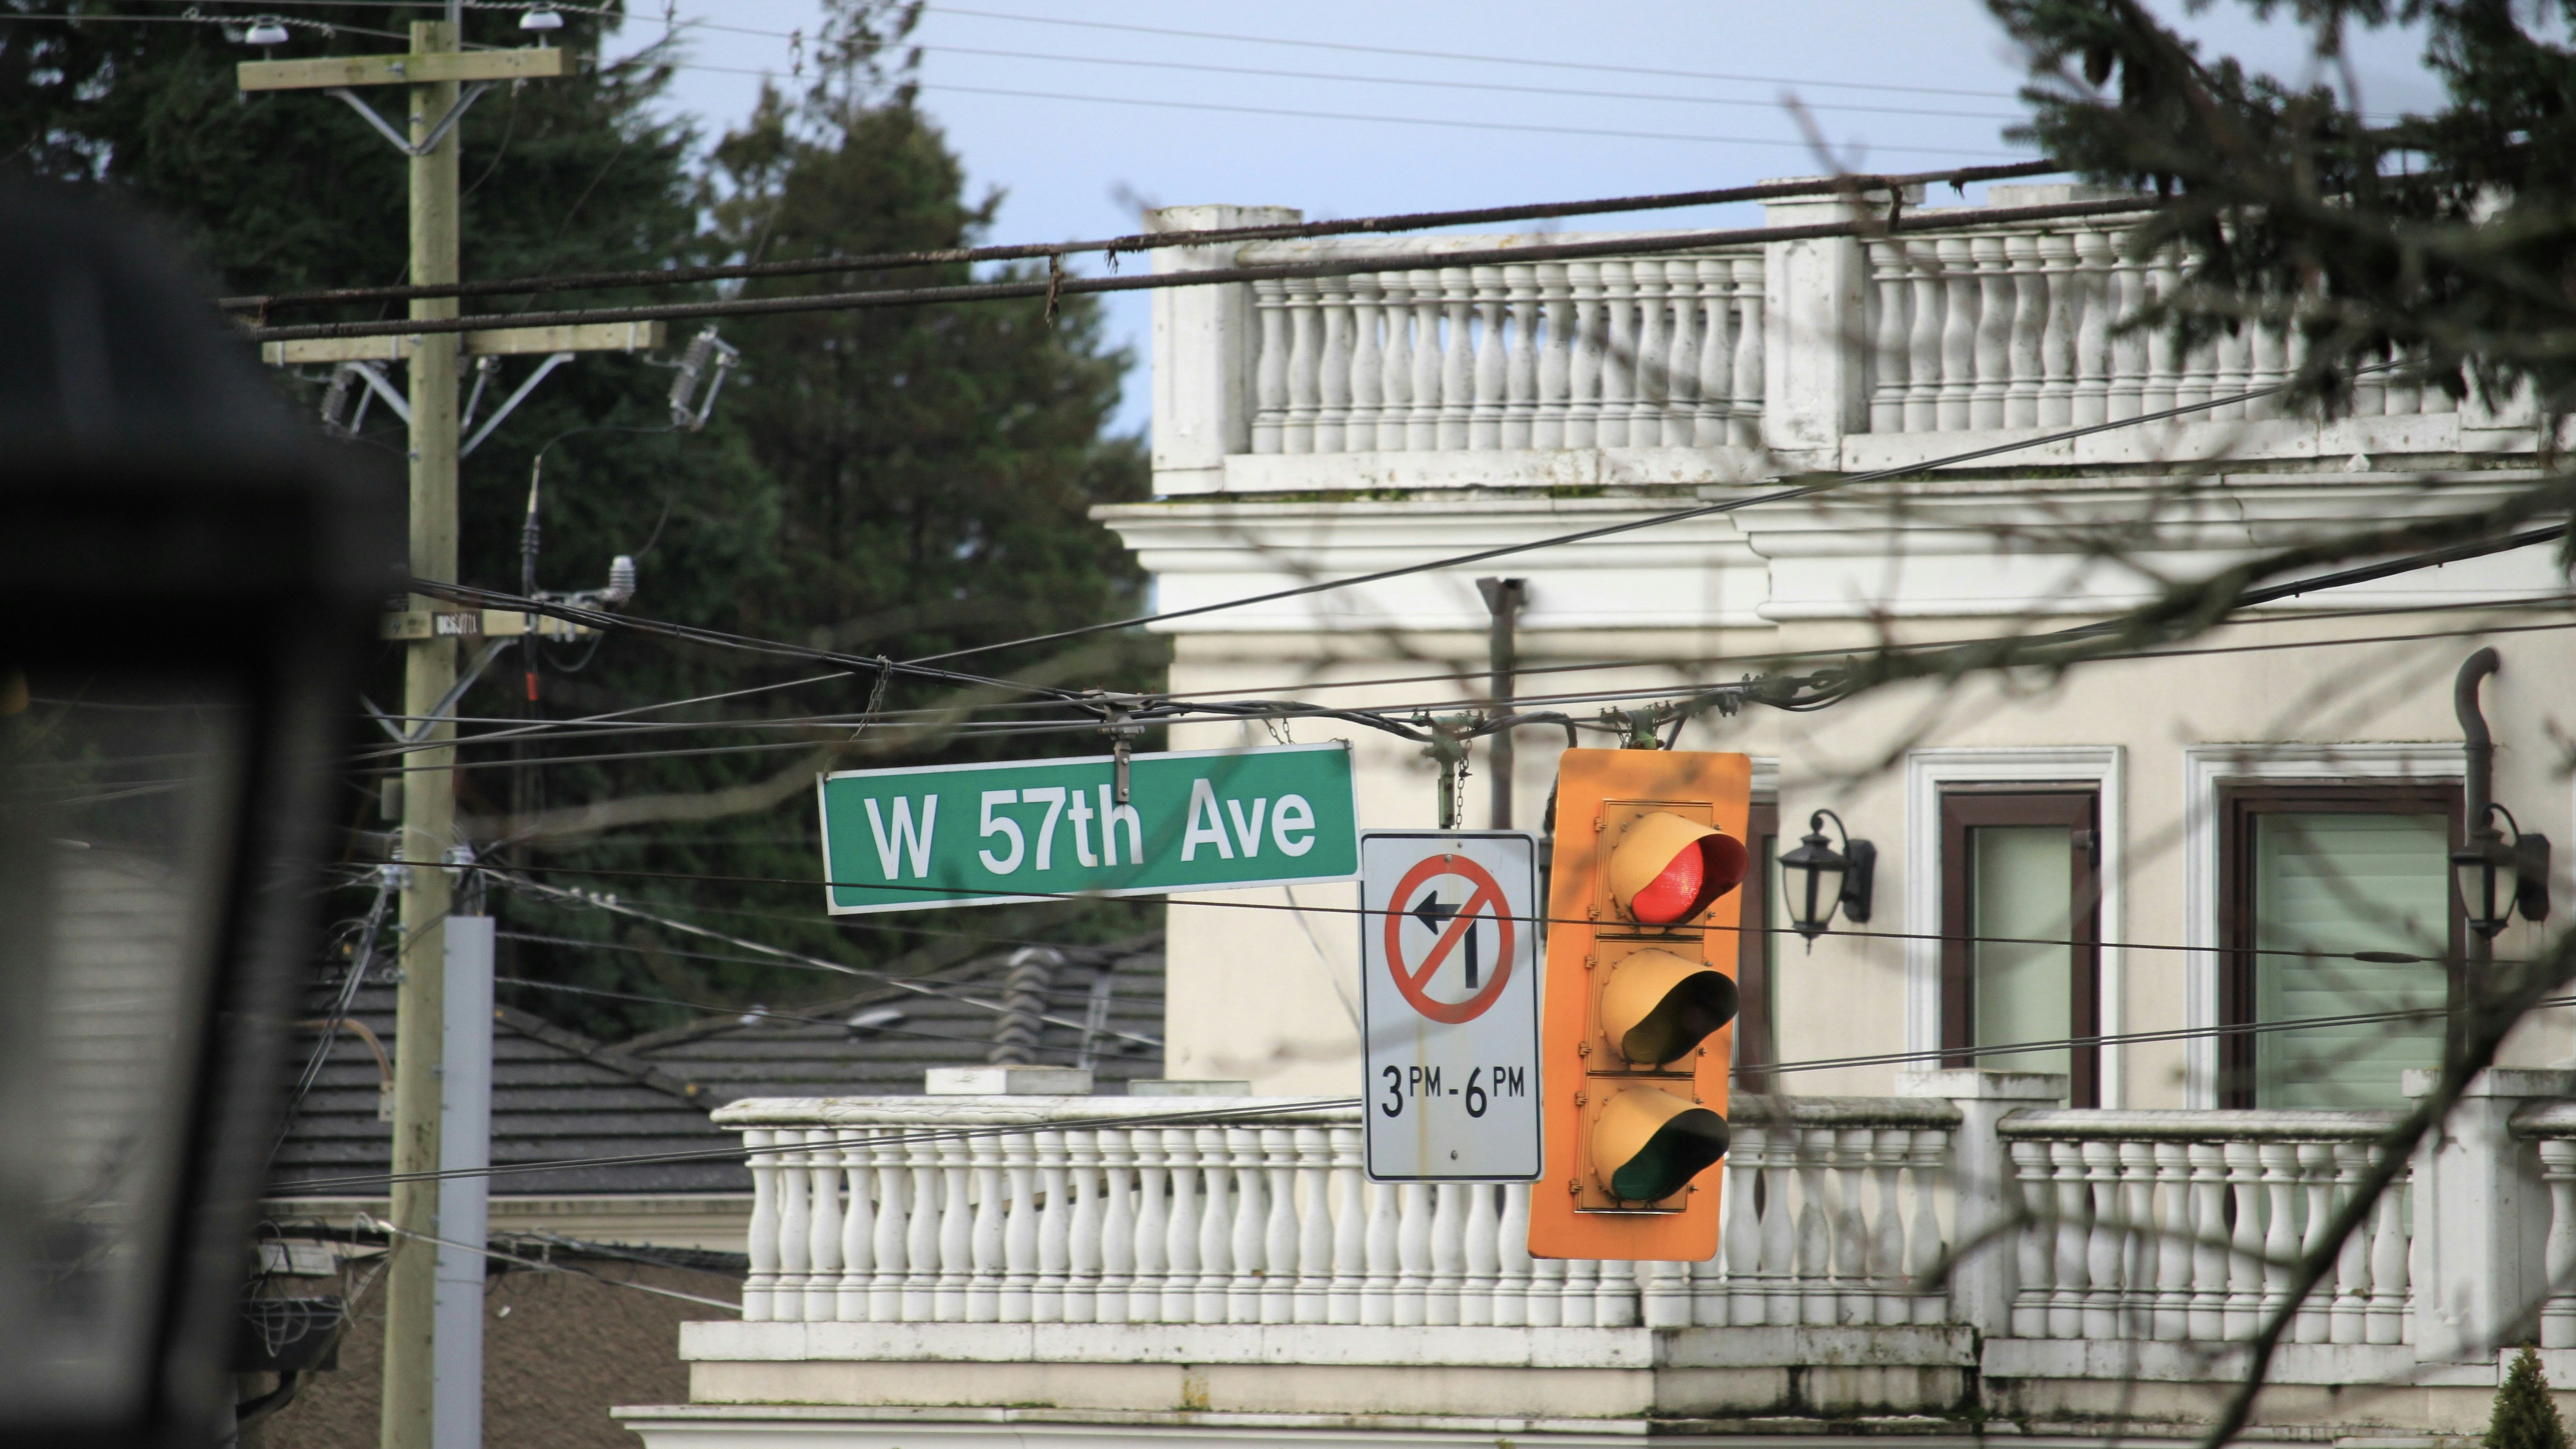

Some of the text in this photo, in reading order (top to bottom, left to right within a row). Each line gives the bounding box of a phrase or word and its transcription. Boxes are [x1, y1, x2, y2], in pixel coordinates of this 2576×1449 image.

[864, 778, 1316, 880] W 57th Ave
